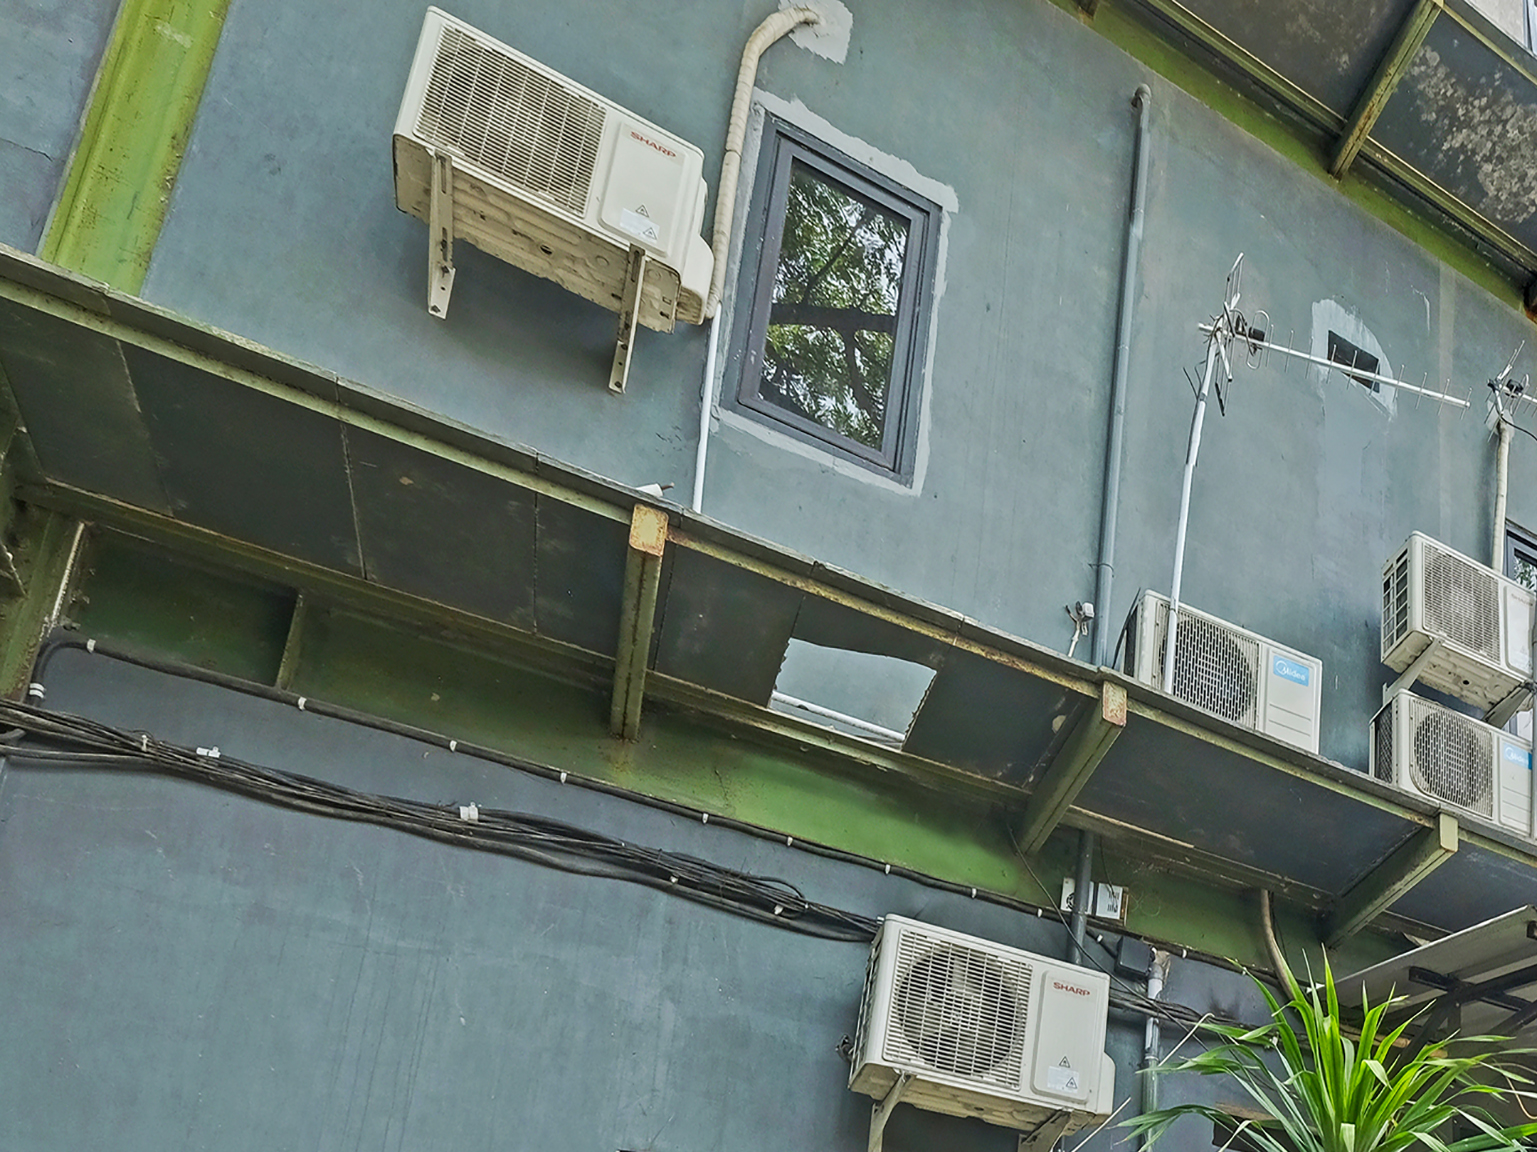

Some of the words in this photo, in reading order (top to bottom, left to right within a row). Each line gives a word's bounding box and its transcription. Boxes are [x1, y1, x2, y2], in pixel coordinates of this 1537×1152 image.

[630, 131, 676, 157] SHARP
[1277, 661, 1306, 681] Midea
[1053, 981, 1091, 996] SHARP
